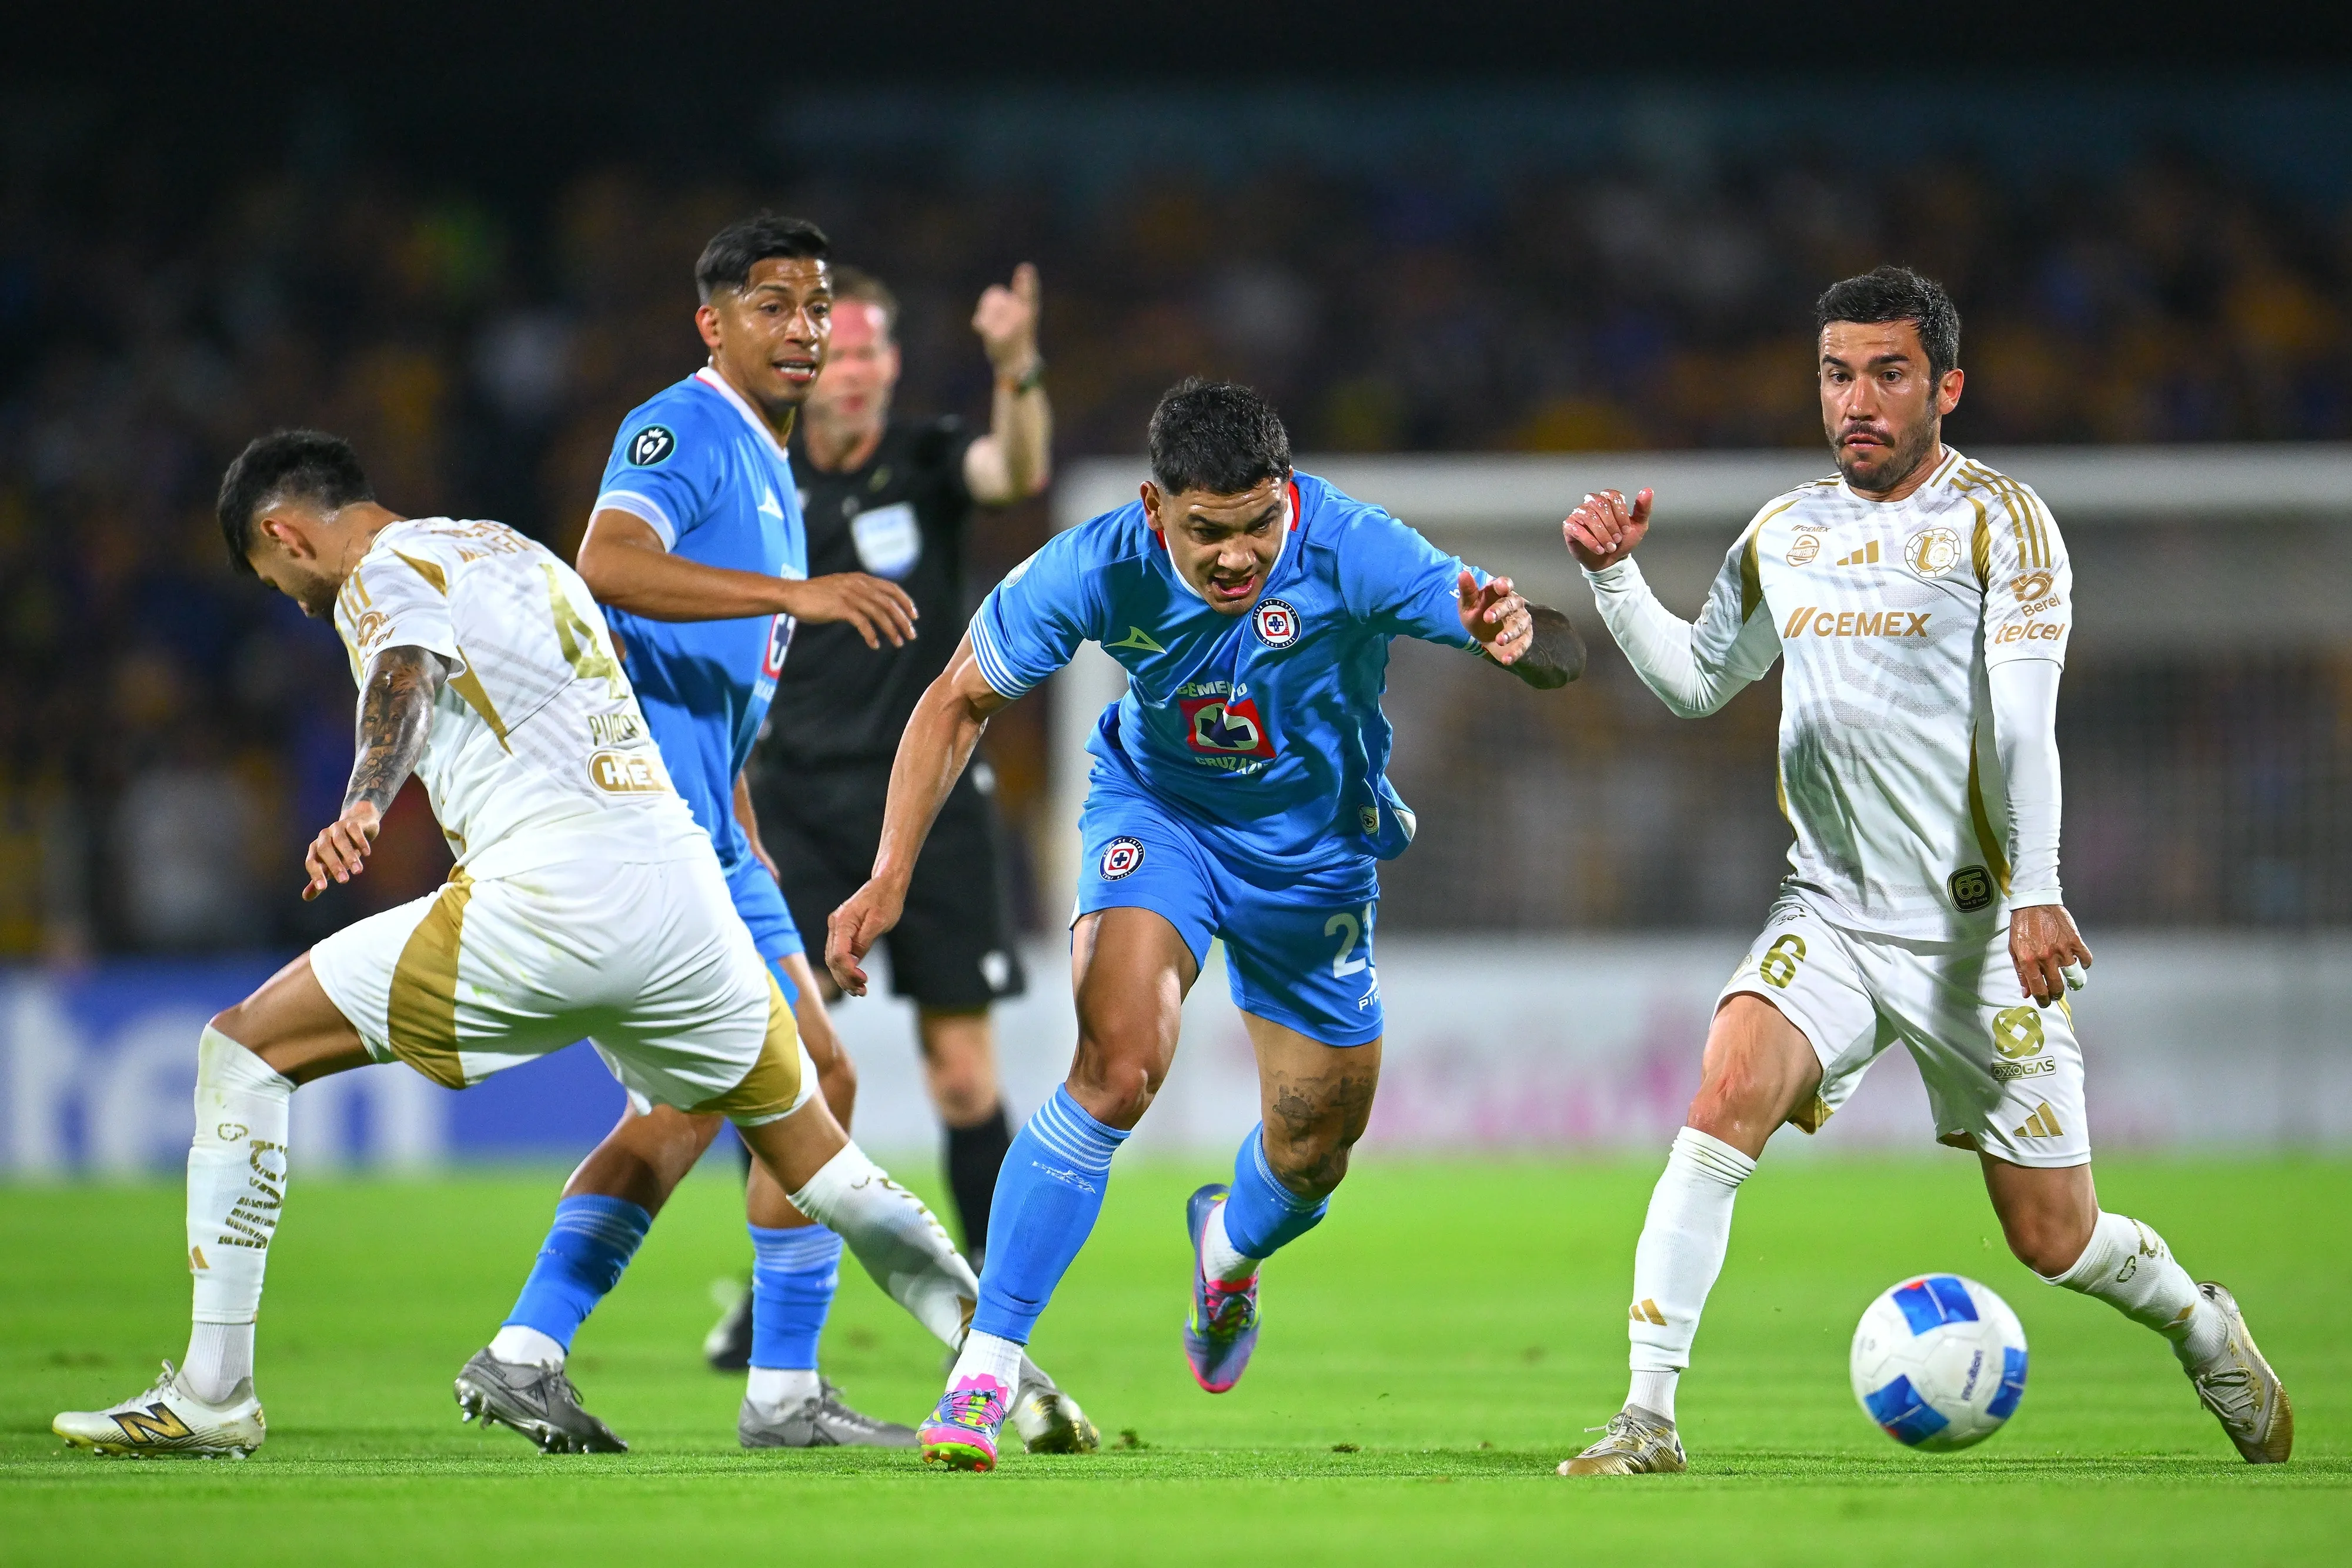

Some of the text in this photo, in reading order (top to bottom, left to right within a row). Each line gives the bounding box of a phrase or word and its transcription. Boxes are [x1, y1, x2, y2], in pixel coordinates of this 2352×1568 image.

[1253, 605, 1263, 620] CLUB
[2021, 593, 2062, 618] Berel
[537, 563, 629, 700] 4
[1813, 611, 1932, 638] CEMEX
[1994, 618, 2066, 645] telcel
[1262, 637, 1295, 647] CRUZ AZUL
[1194, 756, 1236, 771] CRUZ
[1955, 871, 1986, 900] 65
[1759, 934, 1806, 989] 6
